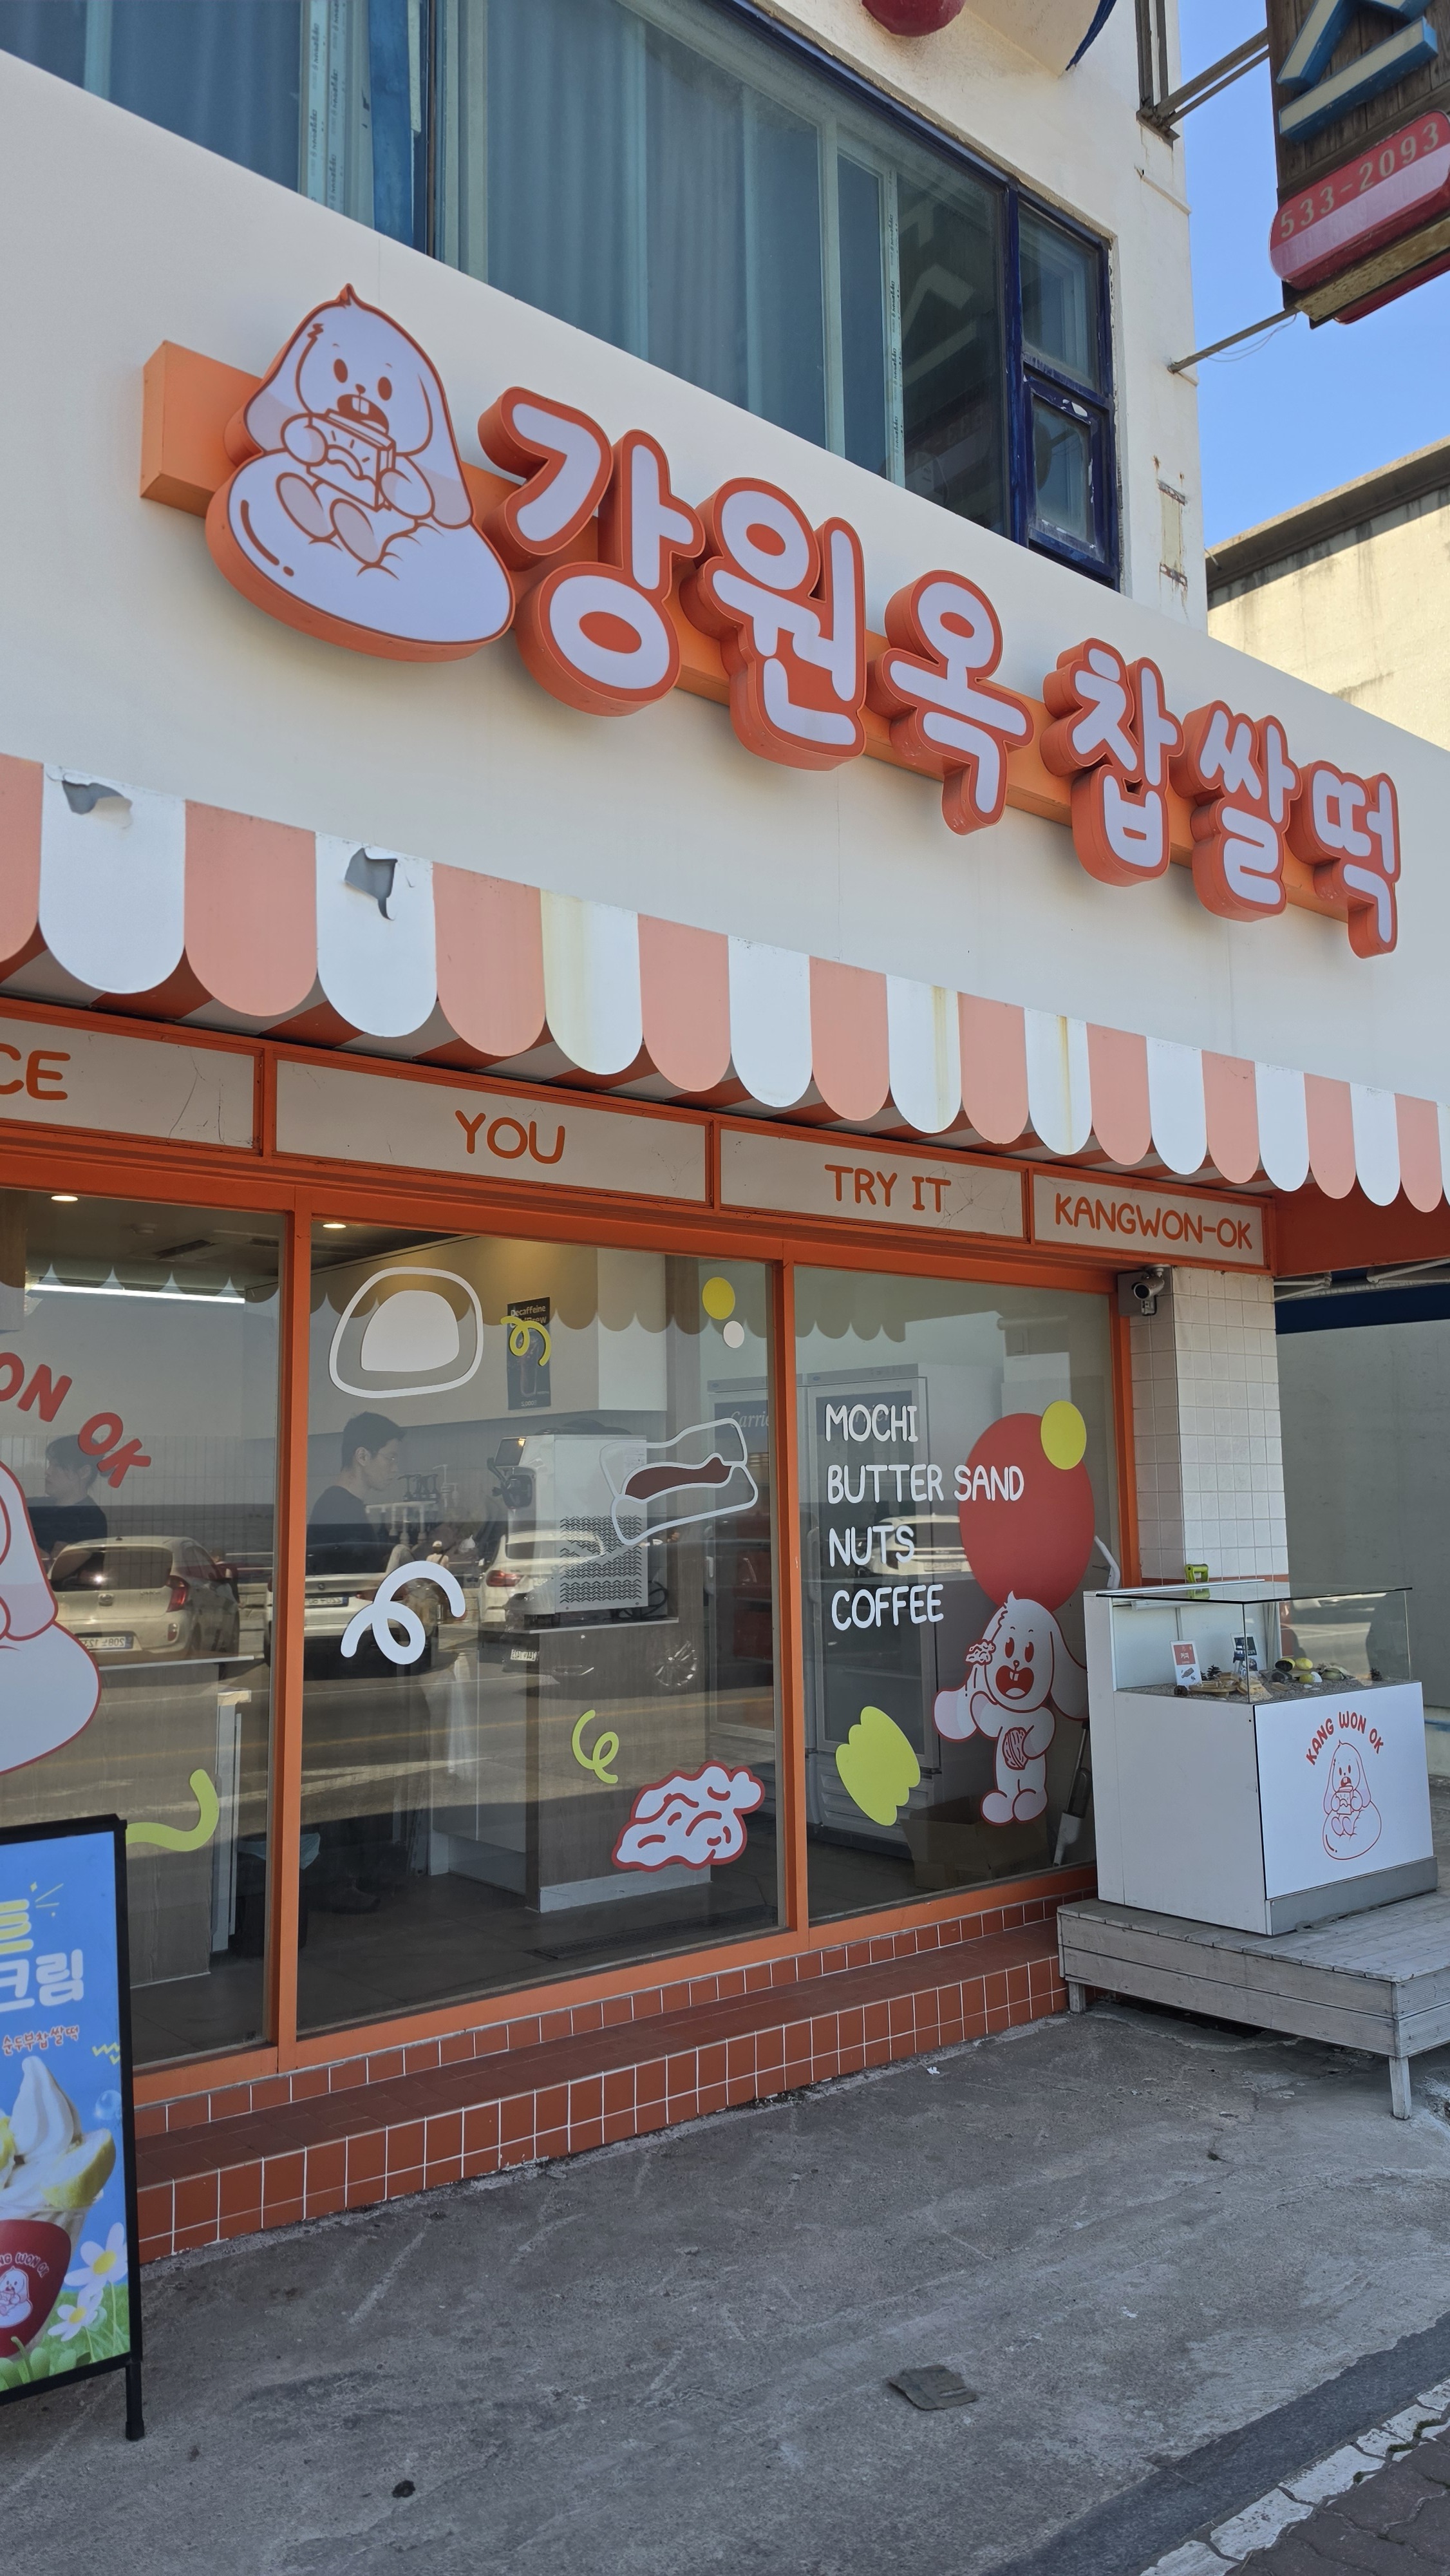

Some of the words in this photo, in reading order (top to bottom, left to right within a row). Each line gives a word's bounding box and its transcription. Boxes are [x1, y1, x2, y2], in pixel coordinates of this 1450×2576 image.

[1280, 122, 1439, 238] 533-2093
[455, 1110, 566, 1164] YOU
[825, 1164, 898, 1207] TRY
[912, 1176, 952, 1213] IT
[1055, 1193, 1253, 1250] KANGWON-OK
[825, 1403, 919, 1443] MOCHI
[77, 1412, 152, 1489] OK
[827, 1463, 945, 1504] BUTTER
[953, 1464, 1025, 1502] SAND
[829, 1524, 916, 1567] NUTS
[831, 1584, 945, 1631] COFFEE
[1306, 1718, 1335, 1766] KANG
[1338, 1710, 1367, 1734] WON
[1369, 1728, 1384, 1754] OK
[15, 2252, 41, 2268] WON
[37, 2262, 50, 2278] OK
